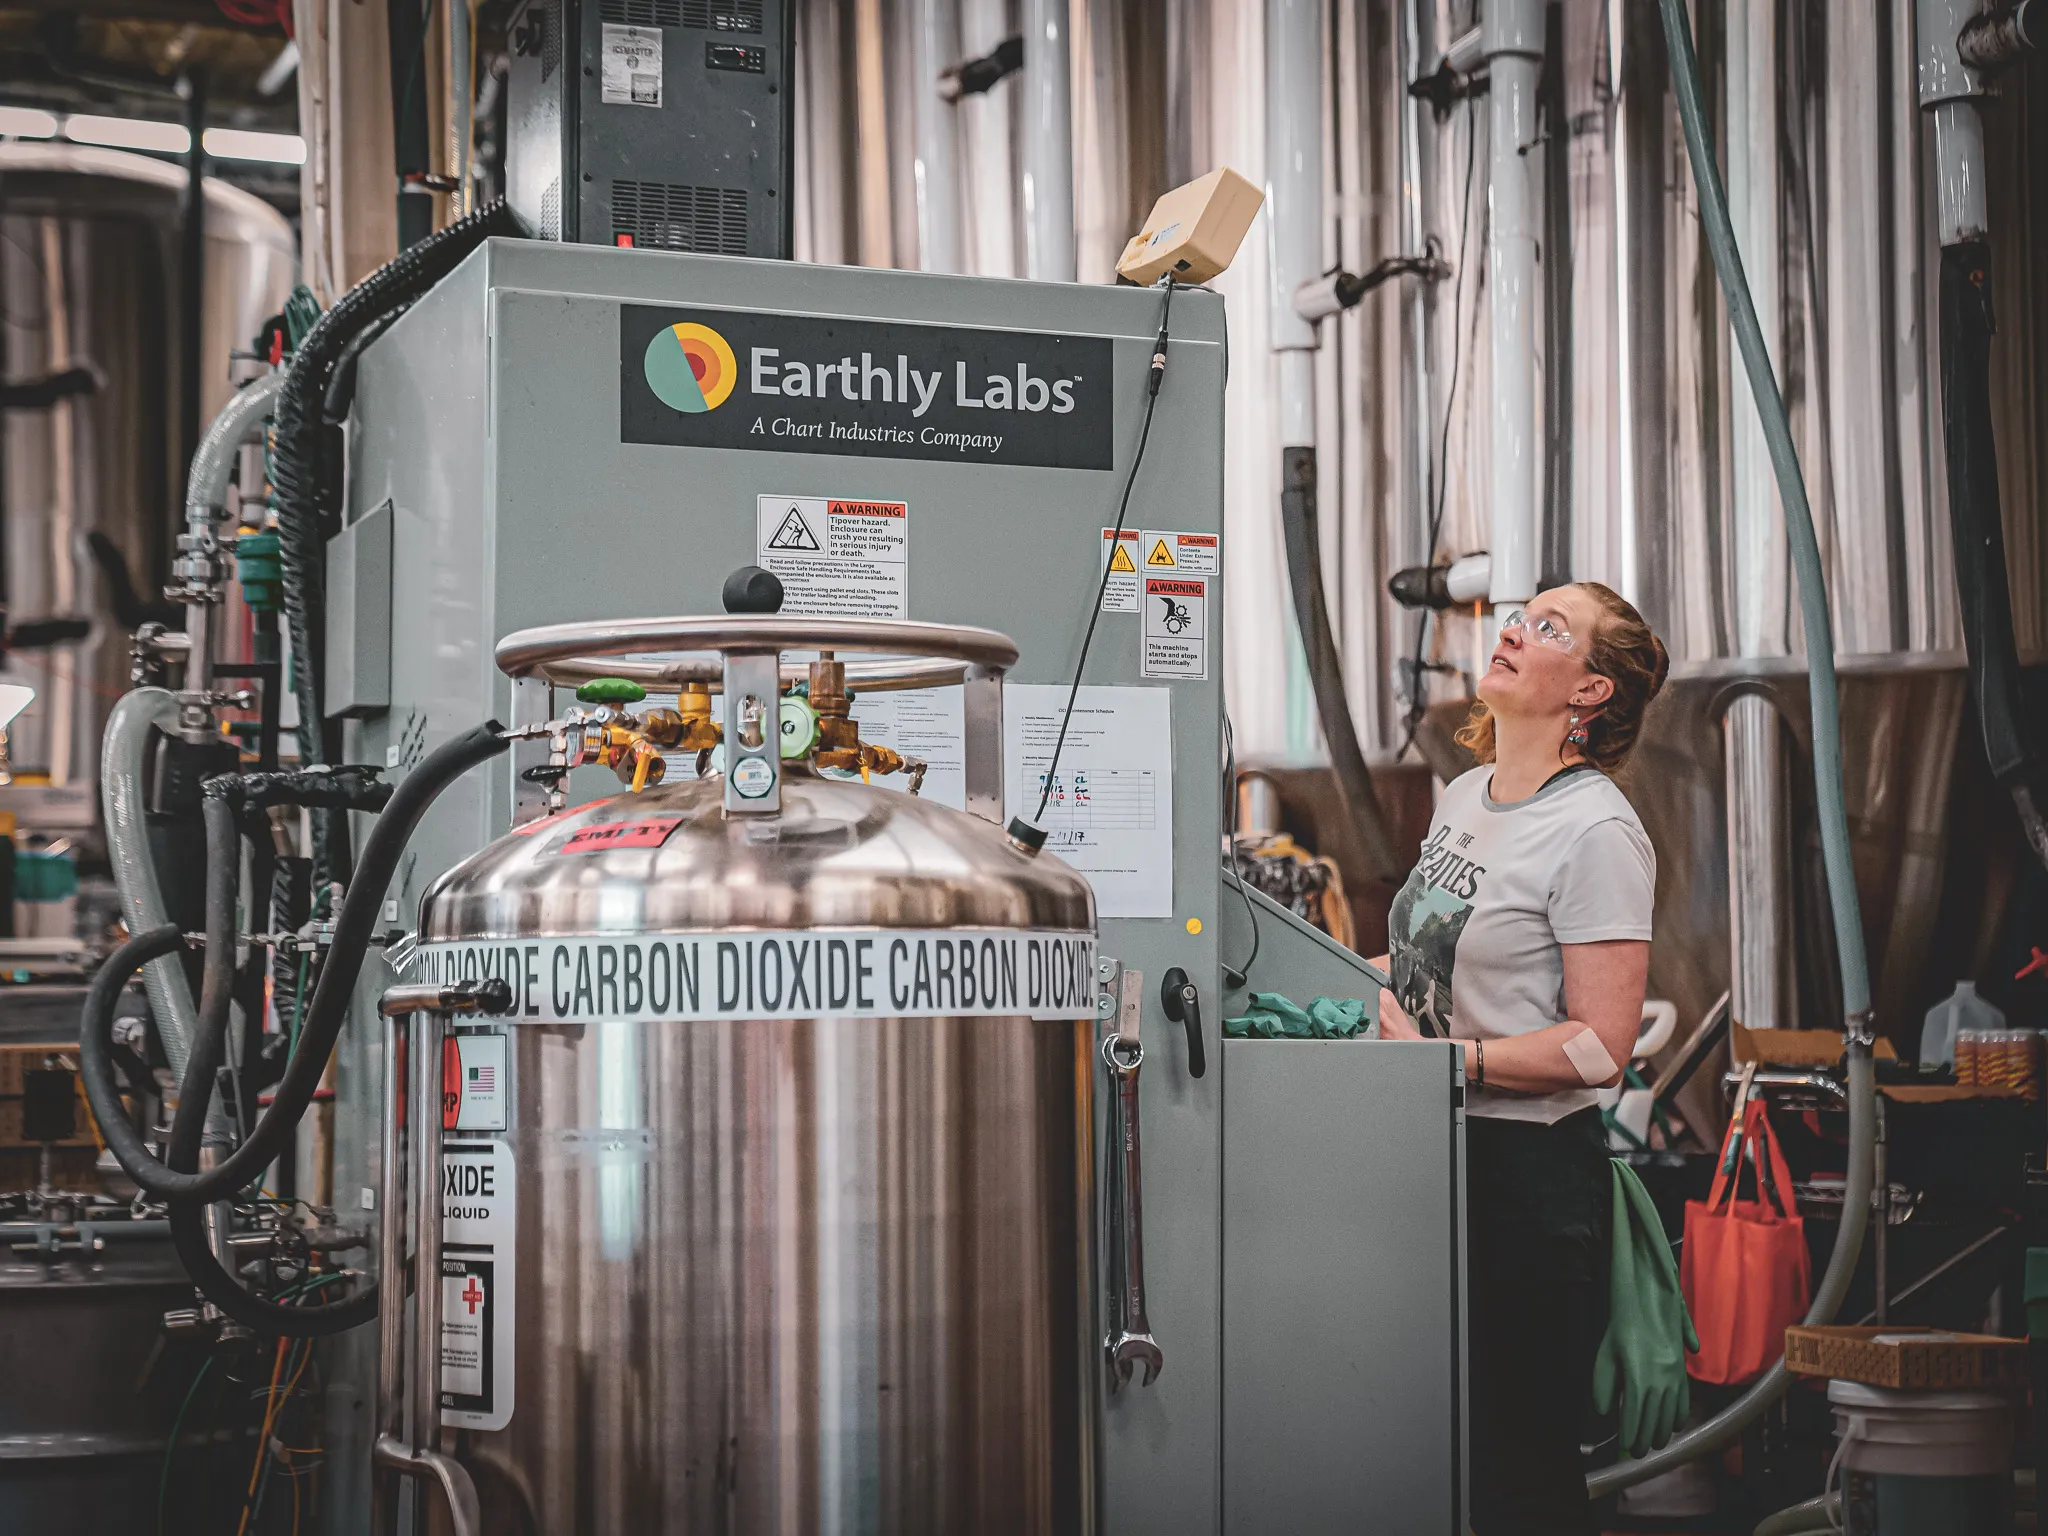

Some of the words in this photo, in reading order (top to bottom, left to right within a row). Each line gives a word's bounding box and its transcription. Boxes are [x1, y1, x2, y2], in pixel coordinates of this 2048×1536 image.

[751, 347, 942, 418] Earthly
[750, 417, 765, 434] A
[771, 418, 823, 438] Chart
[829, 421, 915, 444] Industries
[920, 427, 1003, 452] Company
[846, 504, 901, 516] WARNING
[830, 516, 860, 525] Tipover
[861, 518, 890, 526] hazard.
[830, 525, 867, 533] Enclosure
[869, 535, 904, 544] resulting
[1187, 537, 1214, 545] WARNING
[840, 549, 865, 557] death.
[868, 543, 892, 551] injury
[1158, 582, 1202, 595] WARNING
[1148, 659, 1192, 667] automatically.
[1456, 832, 1475, 849] THE
[1421, 824, 1487, 900] BEATLES
[551, 941, 701, 1018] CARBON
[717, 938, 875, 1014] DIOXIDE
[889, 937, 1018, 1012] CARBON
[1028, 938, 1094, 1010] DIOXIDE
[443, 1165, 495, 1197] XIDE
